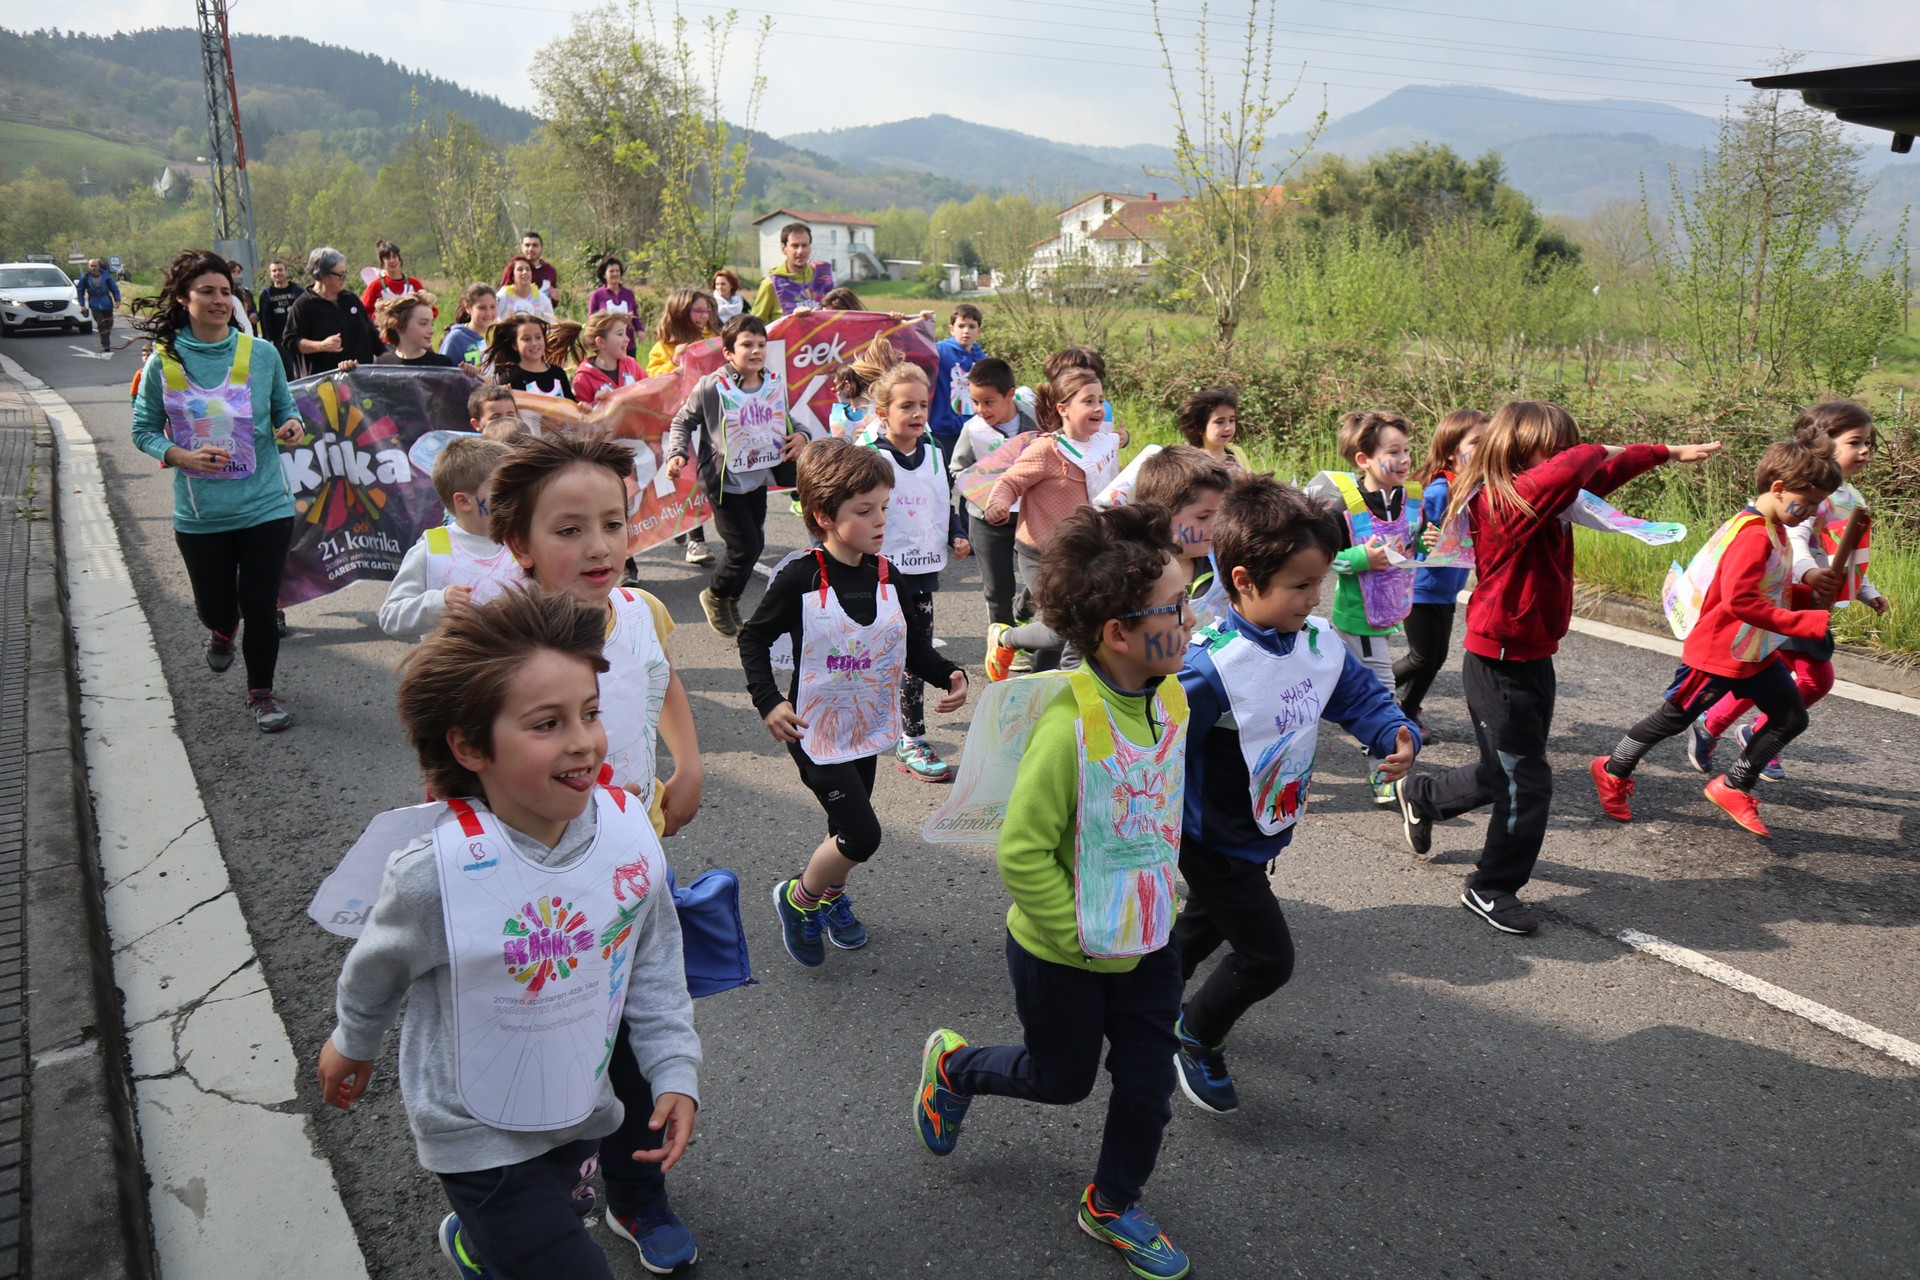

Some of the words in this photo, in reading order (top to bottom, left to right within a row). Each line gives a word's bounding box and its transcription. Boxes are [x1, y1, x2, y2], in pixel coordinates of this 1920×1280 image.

[793, 332, 847, 368] aek
[660, 502, 685, 522] 4tik
[317, 537, 346, 561] 21.
[344, 531, 401, 553] korrika
[901, 551, 942, 567] korrika
[328, 560, 370, 581] GARESTIK
[493, 995, 525, 1006] 2019ko
[528, 992, 567, 1006] apirilaren
